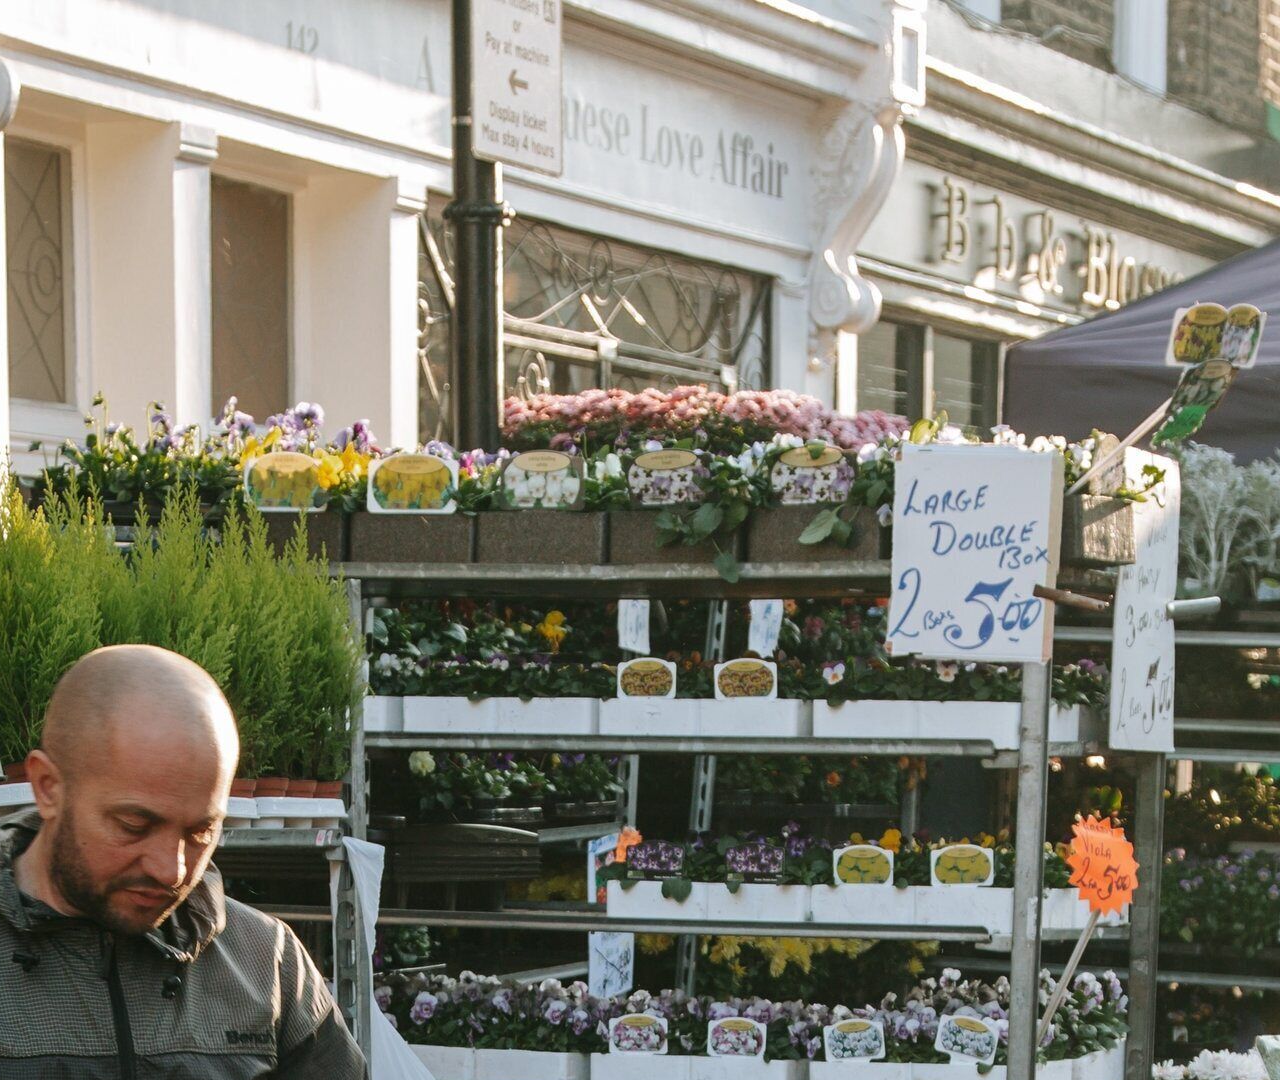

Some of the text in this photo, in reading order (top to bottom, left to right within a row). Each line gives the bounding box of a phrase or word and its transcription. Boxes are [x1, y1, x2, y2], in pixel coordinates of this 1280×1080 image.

[285, 19, 319, 56] 142
[512, 21, 522, 32] or
[485, 31, 550, 66] Pay at machine
[415, 35, 436, 94] A
[639, 104, 704, 177] Love
[711, 128, 789, 199] Affair
[489, 100, 547, 133] Display ticket
[482, 123, 555, 159] Max stay 4 hours
[903, 479, 988, 517] LARGE
[930, 521, 1038, 555] DOUBLE
[890, 568, 921, 638] 2
